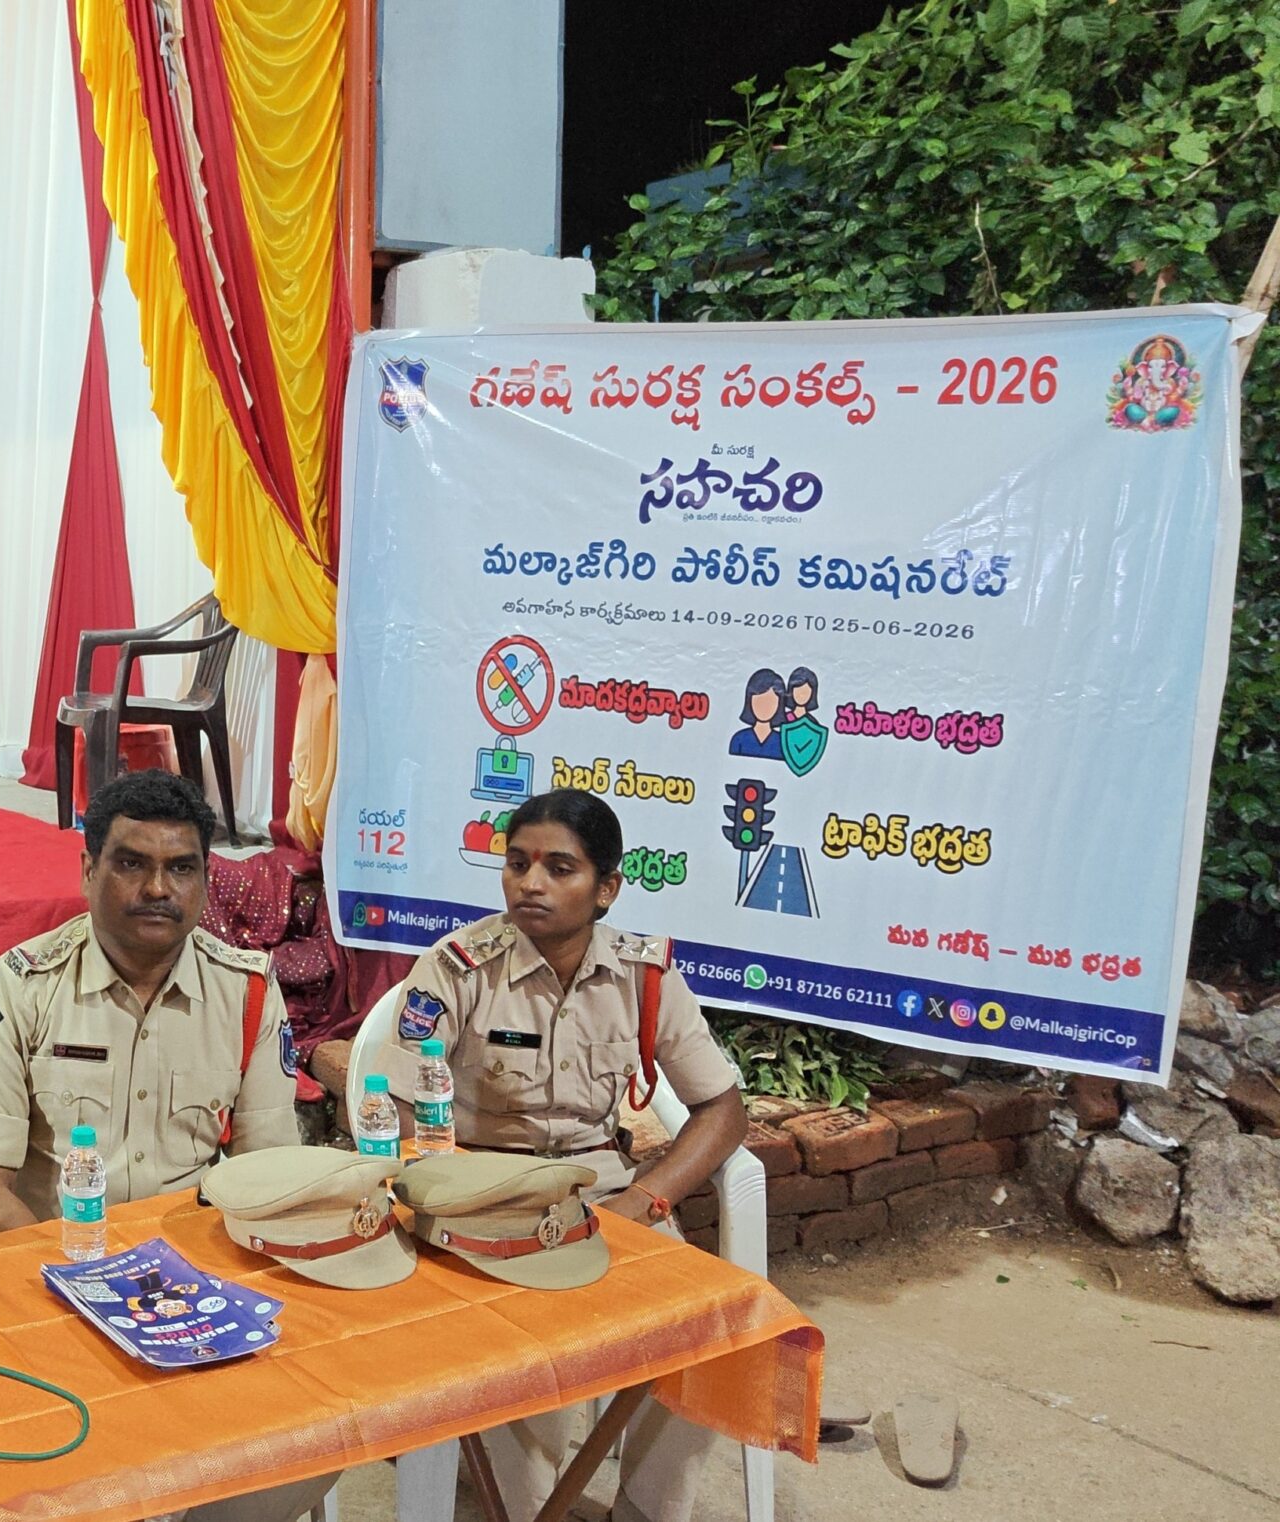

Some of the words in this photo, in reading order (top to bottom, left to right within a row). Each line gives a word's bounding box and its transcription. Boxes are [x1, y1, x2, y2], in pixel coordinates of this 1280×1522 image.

[470, 359, 573, 415] గణేష్
[590, 364, 706, 431] సురక్ష
[720, 360, 877, 425] సంకల్ప్
[937, 355, 1059, 405] 2026
[711, 443, 723, 455] మీ
[671, 543, 781, 587] పోలీస్
[797, 548, 1012, 600] కమిషనరేట్
[502, 596, 575, 619] అవగాహన
[580, 600, 666, 626] కార్యక్రమాలు
[671, 609, 798, 630] 14-09-2026
[804, 615, 827, 631] TO
[831, 617, 975, 640] 25-06-2026
[559, 675, 710, 730] మాదకద్రవ్యాలు
[834, 701, 934, 742] మహిళల
[934, 710, 1004, 755] భద్రత
[615, 760, 696, 805] నేరాలు
[359, 808, 407, 828] డయల్
[357, 828, 406, 856] 112
[821, 812, 910, 860] ట్రాఫిక్
[911, 822, 992, 874] భద్రత
[622, 846, 688, 892] భద్రత
[388, 910, 448, 931] Malkajgiri
[452, 917, 475, 930] Po
[673, 959, 695, 974] 126
[698, 963, 742, 983] 62666
[1081, 952, 1142, 981] భద్రత
[767, 976, 792, 992] +91
[796, 980, 842, 1000] 87126
[846, 988, 893, 1008] 62111
[1009, 1015, 1138, 1049] @MalkajgiriCop
[415, 1104, 438, 1115] isleri
[154, 1323, 213, 1340] DRUGS
[195, 1330, 217, 1341] SAY
